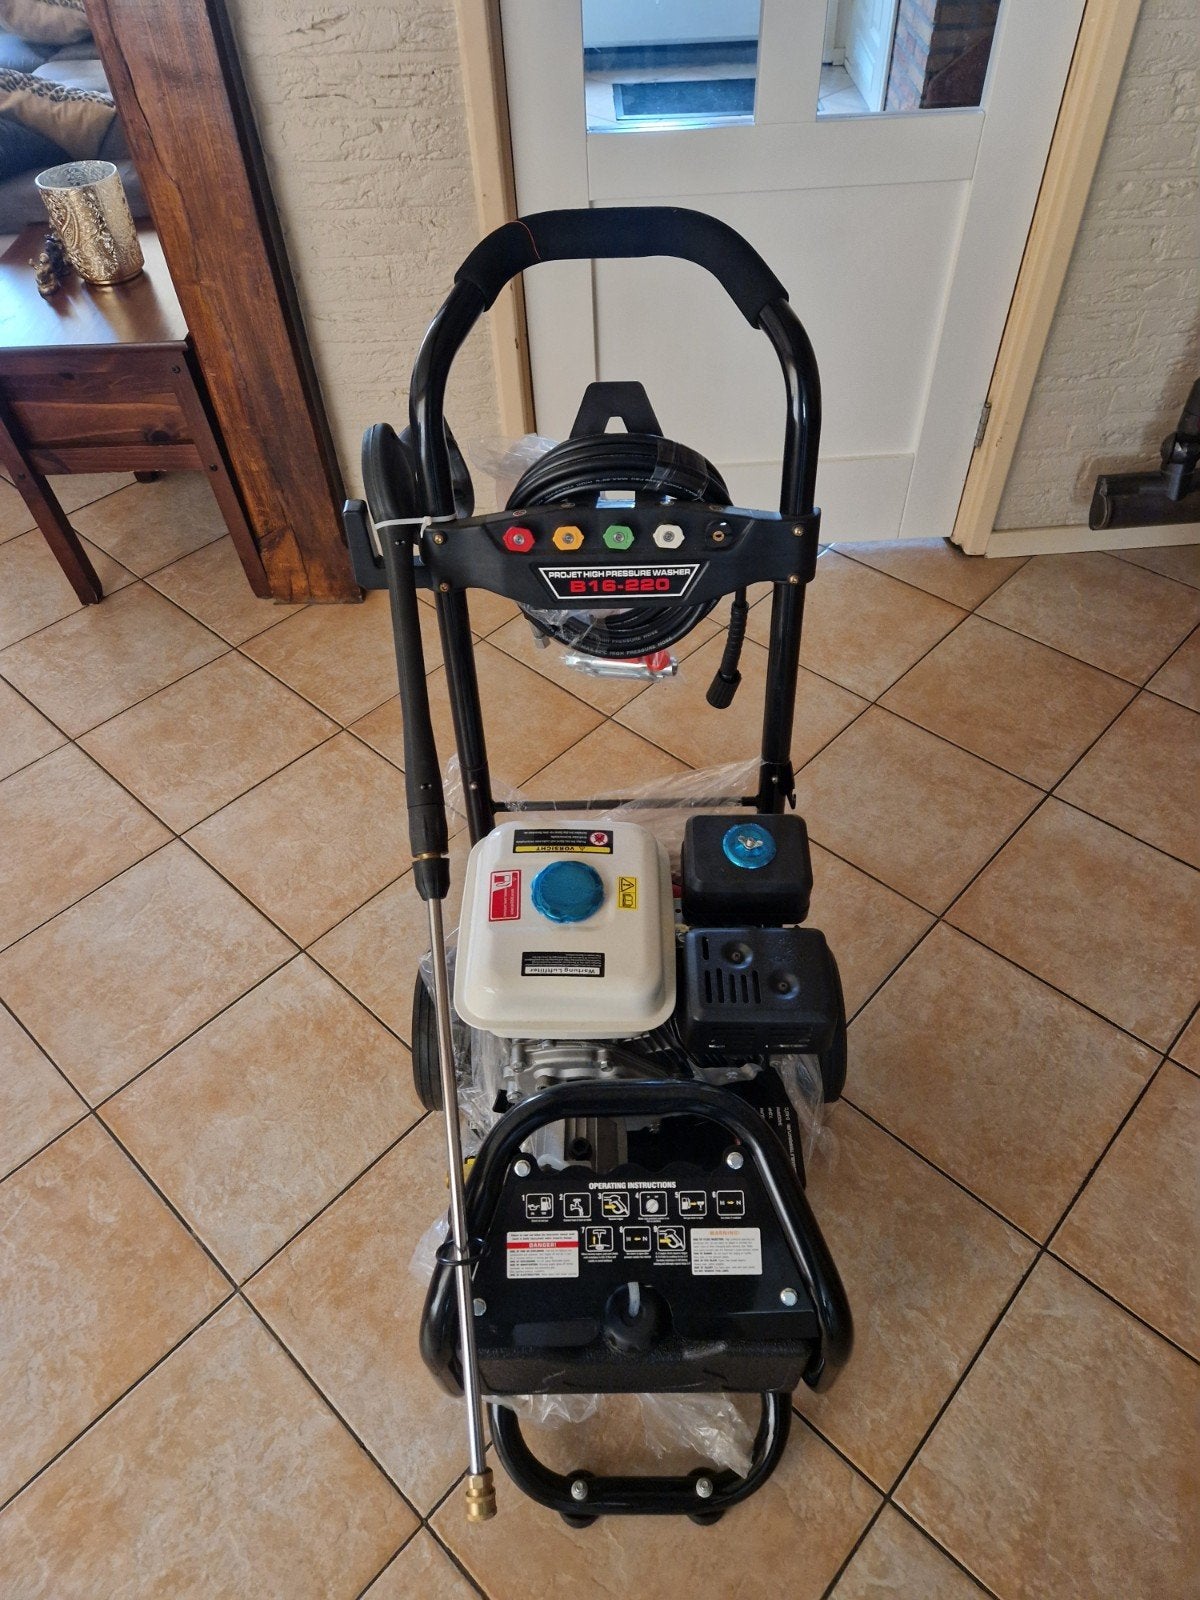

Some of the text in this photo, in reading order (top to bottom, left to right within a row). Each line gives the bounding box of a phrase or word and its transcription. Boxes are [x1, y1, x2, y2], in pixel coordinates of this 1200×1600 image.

[548, 568, 691, 579] PROJET HIGH PRESSURE WASHER
[570, 578, 670, 592] B16-220
[626, 645, 656, 655] PRESSURE
[588, 1181, 676, 1190] OPERATING INSTRUCTIONS
